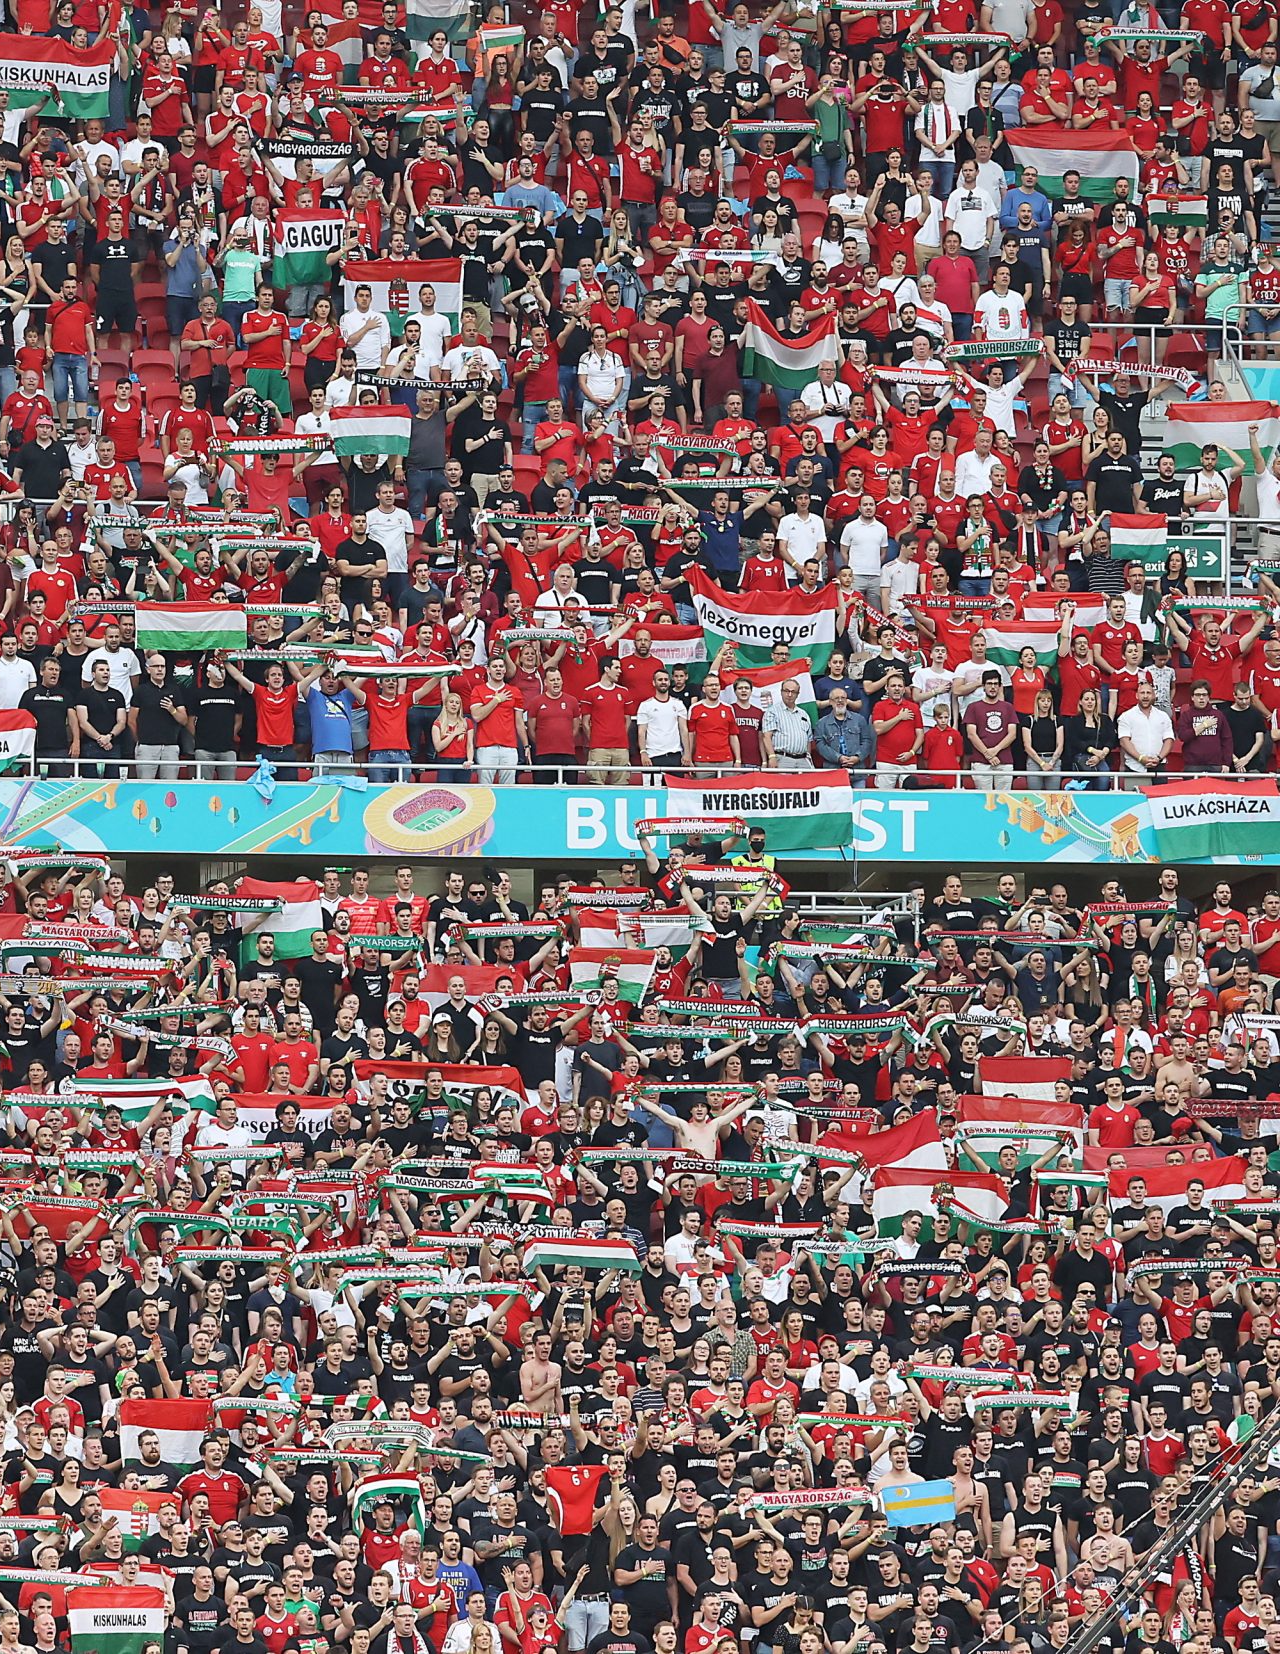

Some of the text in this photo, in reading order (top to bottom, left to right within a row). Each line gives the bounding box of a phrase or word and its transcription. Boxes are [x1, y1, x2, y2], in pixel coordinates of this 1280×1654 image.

[1077, 360, 1179, 377] WALES HUNGARY
[1144, 562, 1165, 572] exit
[701, 602, 816, 647] Mezőmegyer
[701, 791, 820, 811] NYERGESÚJFALU
[1164, 799, 1270, 821] LUKÁCSHÁZA
[660, 980, 671, 990] 29
[739, 1164, 768, 1174] UEFA
[759, 1344, 770, 1354] 30
[573, 1476, 579, 1485] 6
[94, 1615, 147, 1627] KISKUNHALAS
